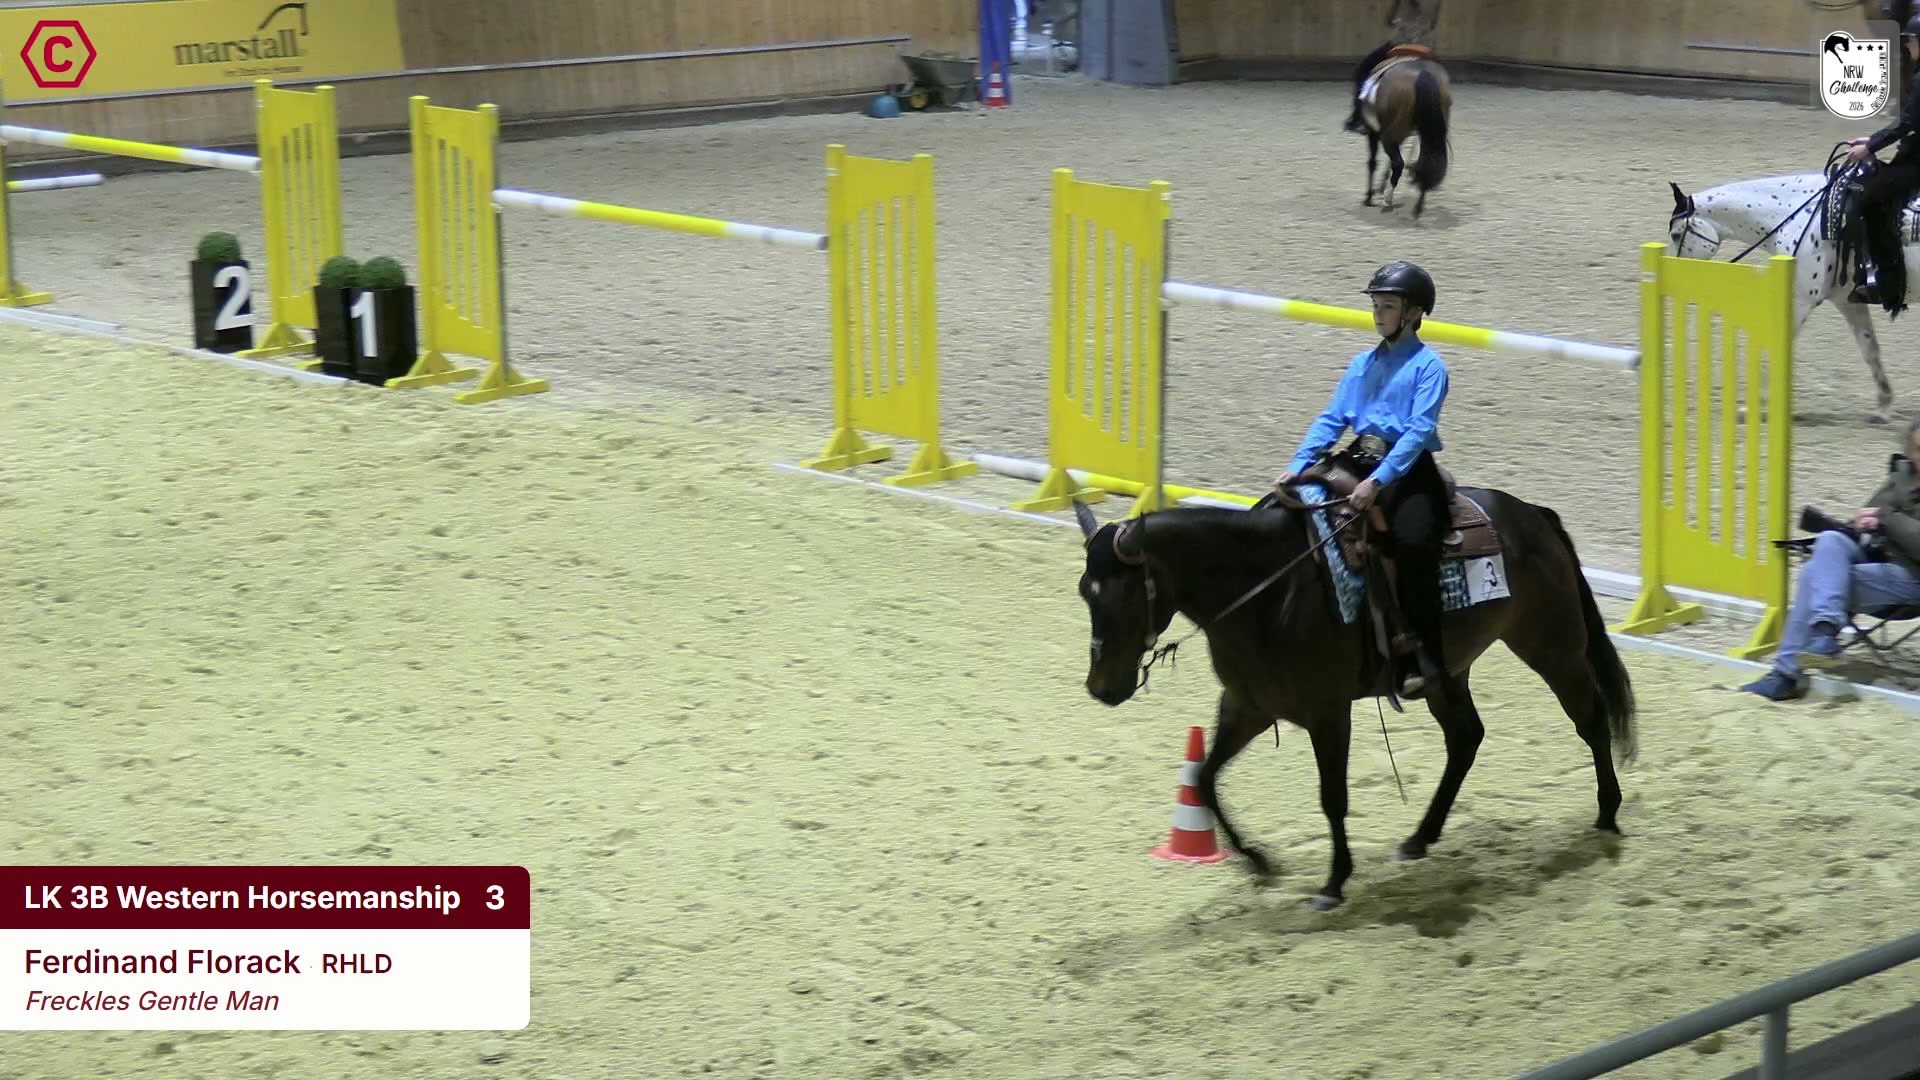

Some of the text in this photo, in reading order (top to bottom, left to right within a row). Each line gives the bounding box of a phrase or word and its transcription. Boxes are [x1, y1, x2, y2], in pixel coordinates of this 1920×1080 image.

[174, 28, 299, 66] marstall
[213, 266, 256, 331] 2
[350, 292, 378, 358] 1
